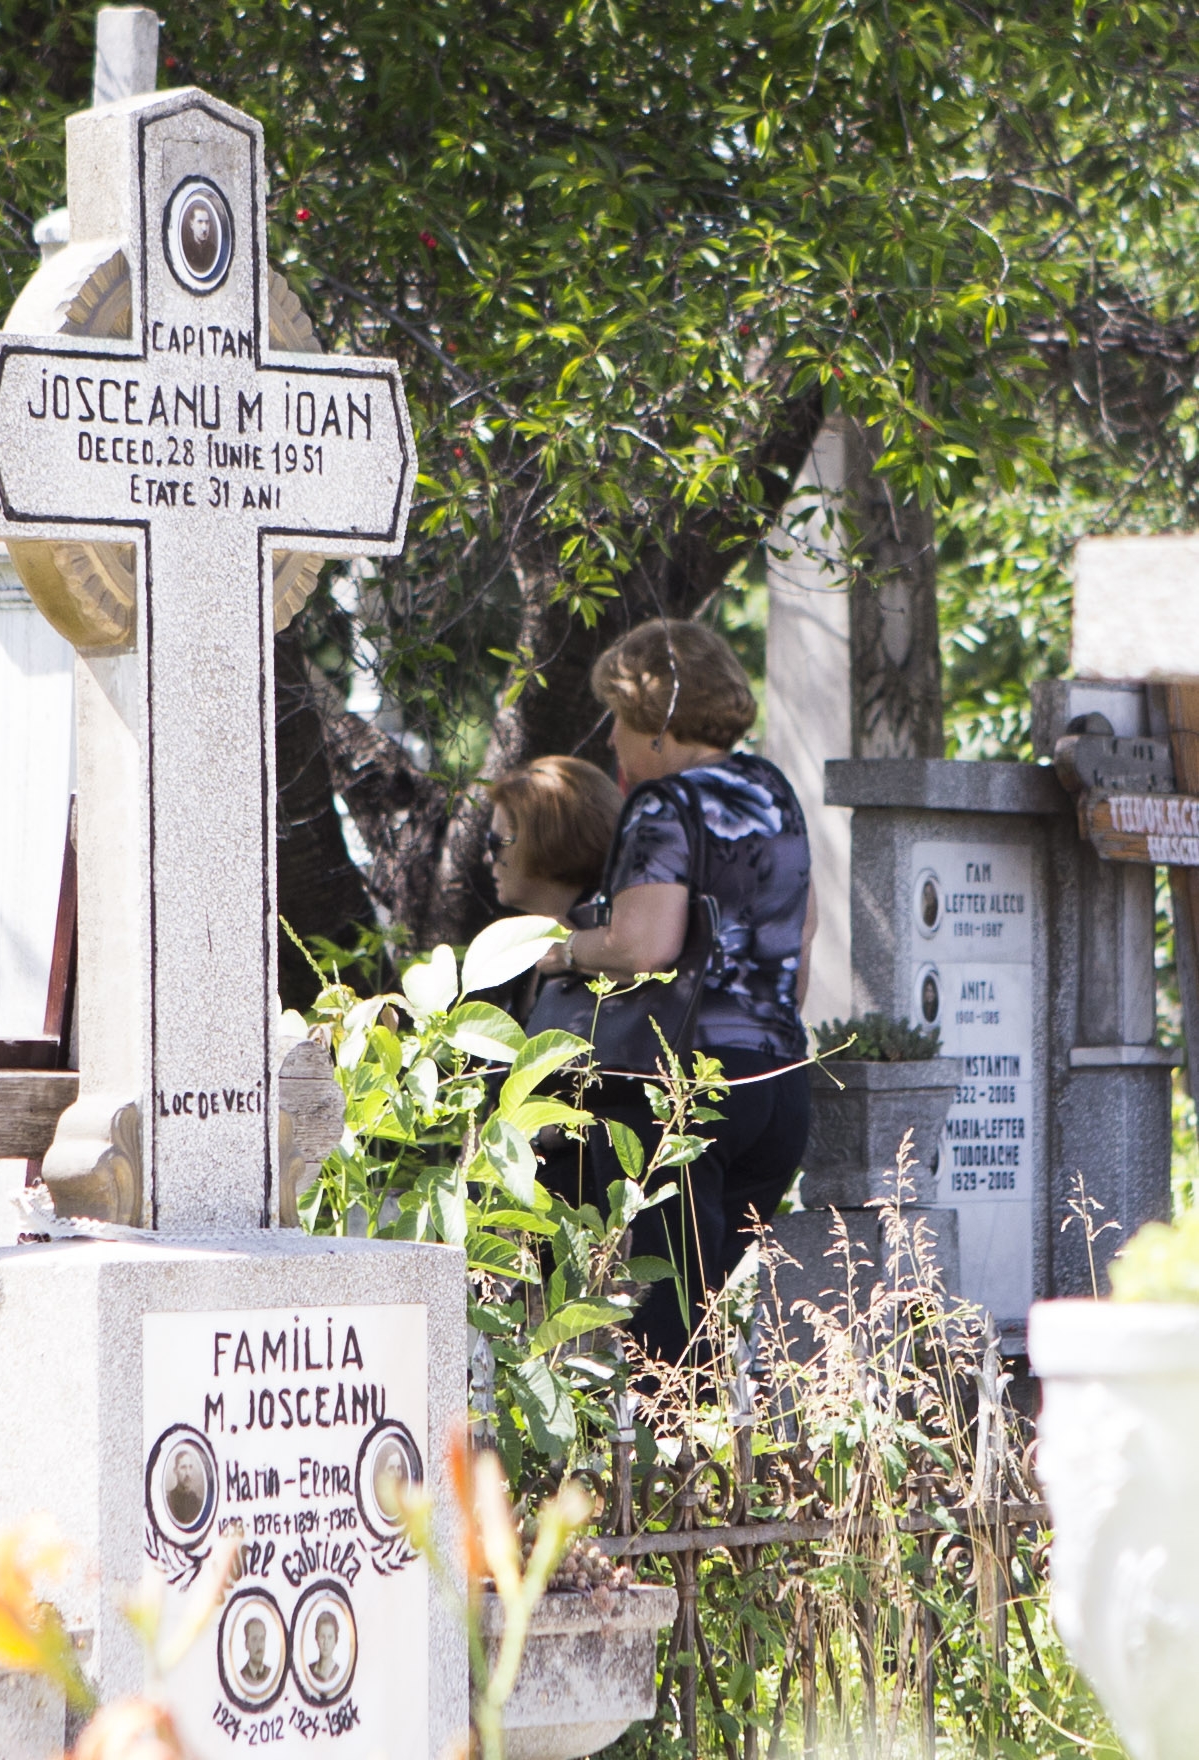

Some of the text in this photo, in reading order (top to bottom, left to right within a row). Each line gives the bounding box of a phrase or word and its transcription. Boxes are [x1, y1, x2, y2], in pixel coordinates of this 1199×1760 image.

[152, 322, 253, 359] CAPITAN
[28, 369, 220, 431] JOSCEANU
[238, 390, 262, 434] M
[167, 435, 195, 467] 28
[271, 441, 323, 475] 1951
[130, 474, 280, 509] ETATE 31 ANI
[945, 893, 1025, 914] LEFTER ALECU
[965, 1056, 1020, 1077] NSTANTIN
[160, 1090, 194, 1117] LOC
[952, 1145, 1019, 1167] TUDORACHE
[204, 1382, 386, 1434] M. JOSCEANU
